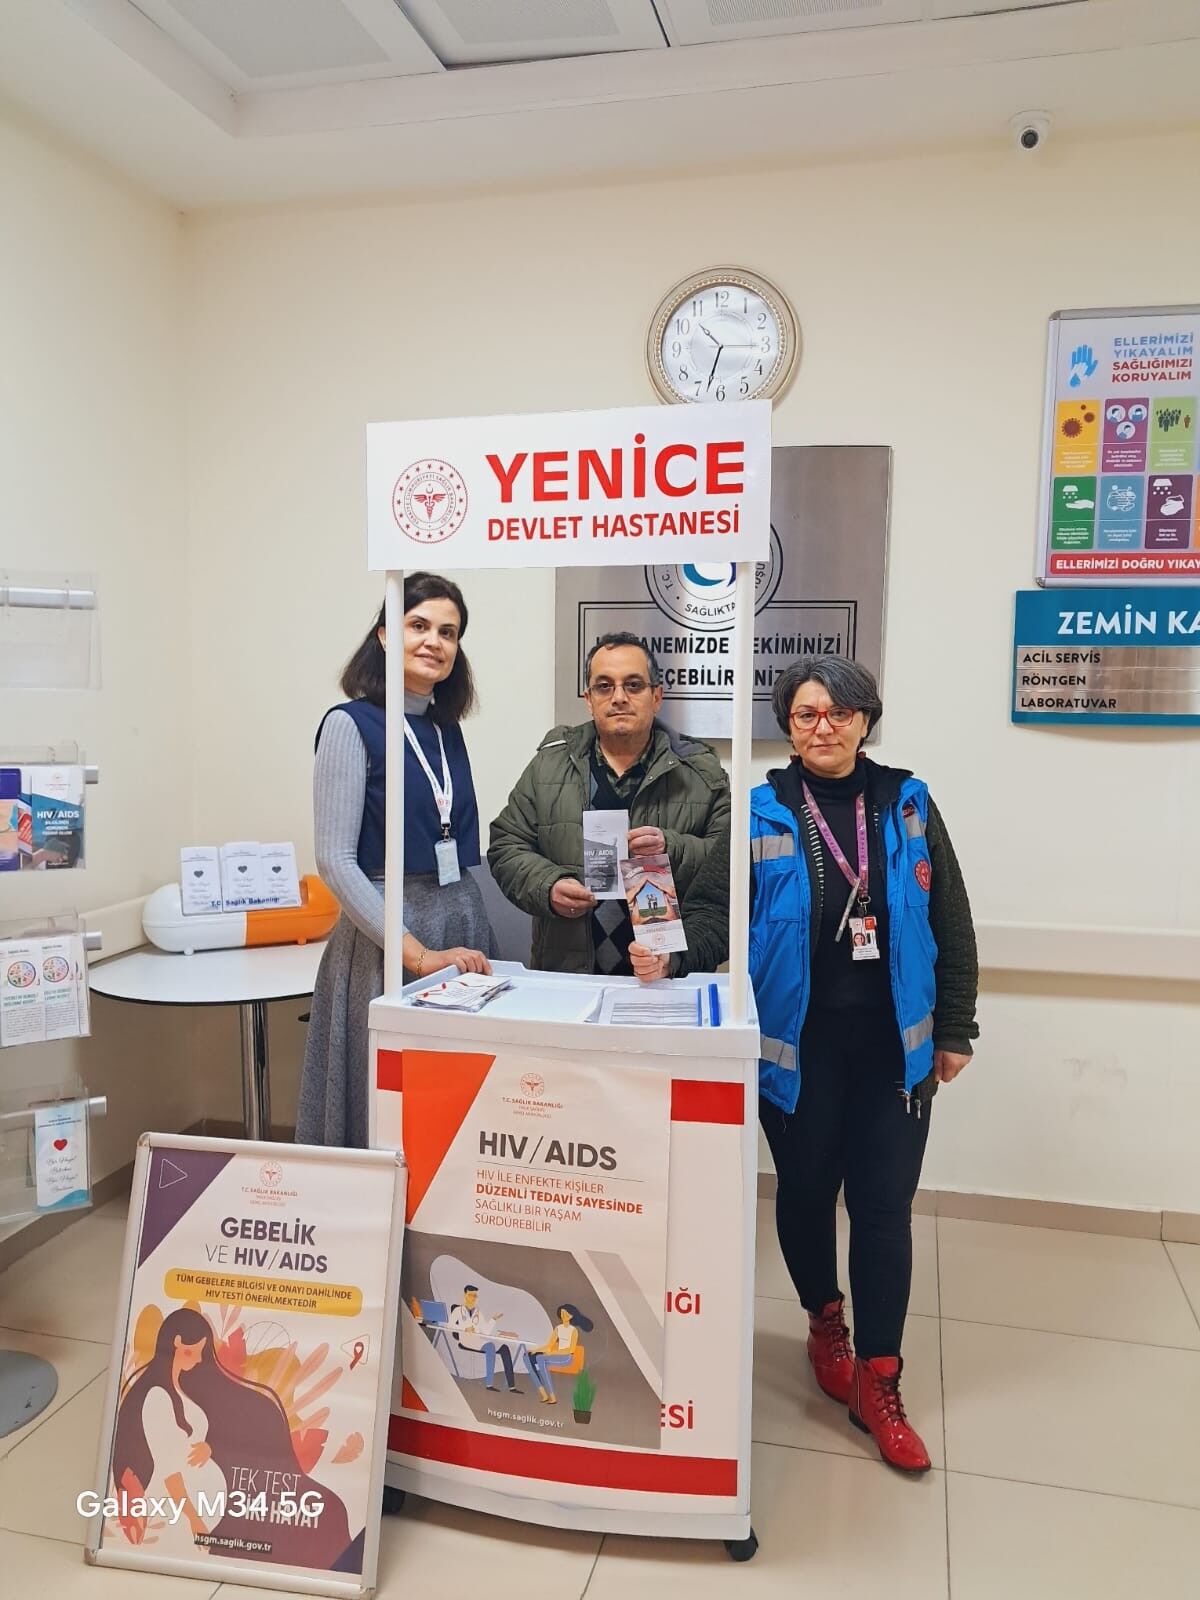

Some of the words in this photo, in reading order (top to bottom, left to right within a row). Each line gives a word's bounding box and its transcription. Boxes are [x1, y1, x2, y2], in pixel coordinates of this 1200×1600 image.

[715, 290, 729, 308] 12
[693, 300, 703, 316] 11
[676, 318, 690, 335] 10
[757, 313, 766, 330] 2
[761, 336, 770, 353] 3
[1114, 332, 1193, 346] ELLERİMİZİ
[672, 342, 681, 358] 9
[1114, 346, 1192, 358] YIKAYALIM
[754, 359, 763, 375] 4
[1113, 358, 1192, 370] SAĞLIĞIMIZI
[679, 365, 688, 381] 8
[1112, 371, 1191, 382] KORUYALIM
[694, 381, 702, 396] 7
[716, 385, 725, 401] 6
[740, 377, 749, 394] 5
[485, 433, 744, 503] YENİCE
[488, 515, 582, 541] DEVLET
[592, 504, 739, 538] HASTANESİ
[1056, 558, 1119, 569] ELLERİMİZİ
[1122, 557, 1164, 569] DOĞRU
[1058, 604, 1157, 634] ZEMİN
[1023, 650, 1052, 663] ACİL
[1056, 650, 1100, 663] SERVİS
[1022, 673, 1086, 686] RÖNTGEN
[1021, 698, 1116, 708] LABORATUVAR
[479, 1131, 617, 1171] HIV/AIDS
[477, 1169, 494, 1180] HIV
[498, 1169, 512, 1182] İLE
[515, 1174, 561, 1189] ENFEKTE
[565, 1179, 604, 1193] KİŞİLER
[476, 1183, 527, 1199] DÜZENLİ
[530, 1190, 572, 1205] TEDAVİ
[576, 1196, 643, 1214] SAYESİNDE
[475, 1199, 521, 1213] SAĞLIKLI
[544, 1207, 581, 1221] YAŞAM
[475, 1212, 551, 1232] SÜRDÜREBİLİR
[220, 1217, 316, 1246] GEBELİK
[205, 1244, 229, 1263] VE
[234, 1247, 328, 1273] HIV/AIDS
[176, 1273, 194, 1284] TÜM
[195, 1276, 236, 1287] GEBELERE
[237, 1280, 265, 1290] BİLGİSİ
[267, 1283, 277, 1292] VE
[279, 1285, 304, 1295] ONAYI
[306, 1288, 352, 1300] DAHİLİNDE
[205, 1289, 220, 1298] HIV
[222, 1291, 243, 1300] TESTİ
[245, 1293, 317, 1308] ÖNERİLMEKTEDİR
[487, 1408, 564, 1428] hsgm.saglik.gov.tr
[232, 1466, 259, 1492] TEK
[264, 1470, 301, 1497] TEST
[195, 1535, 272, 1551] hsgm.saglik.gov.tr
